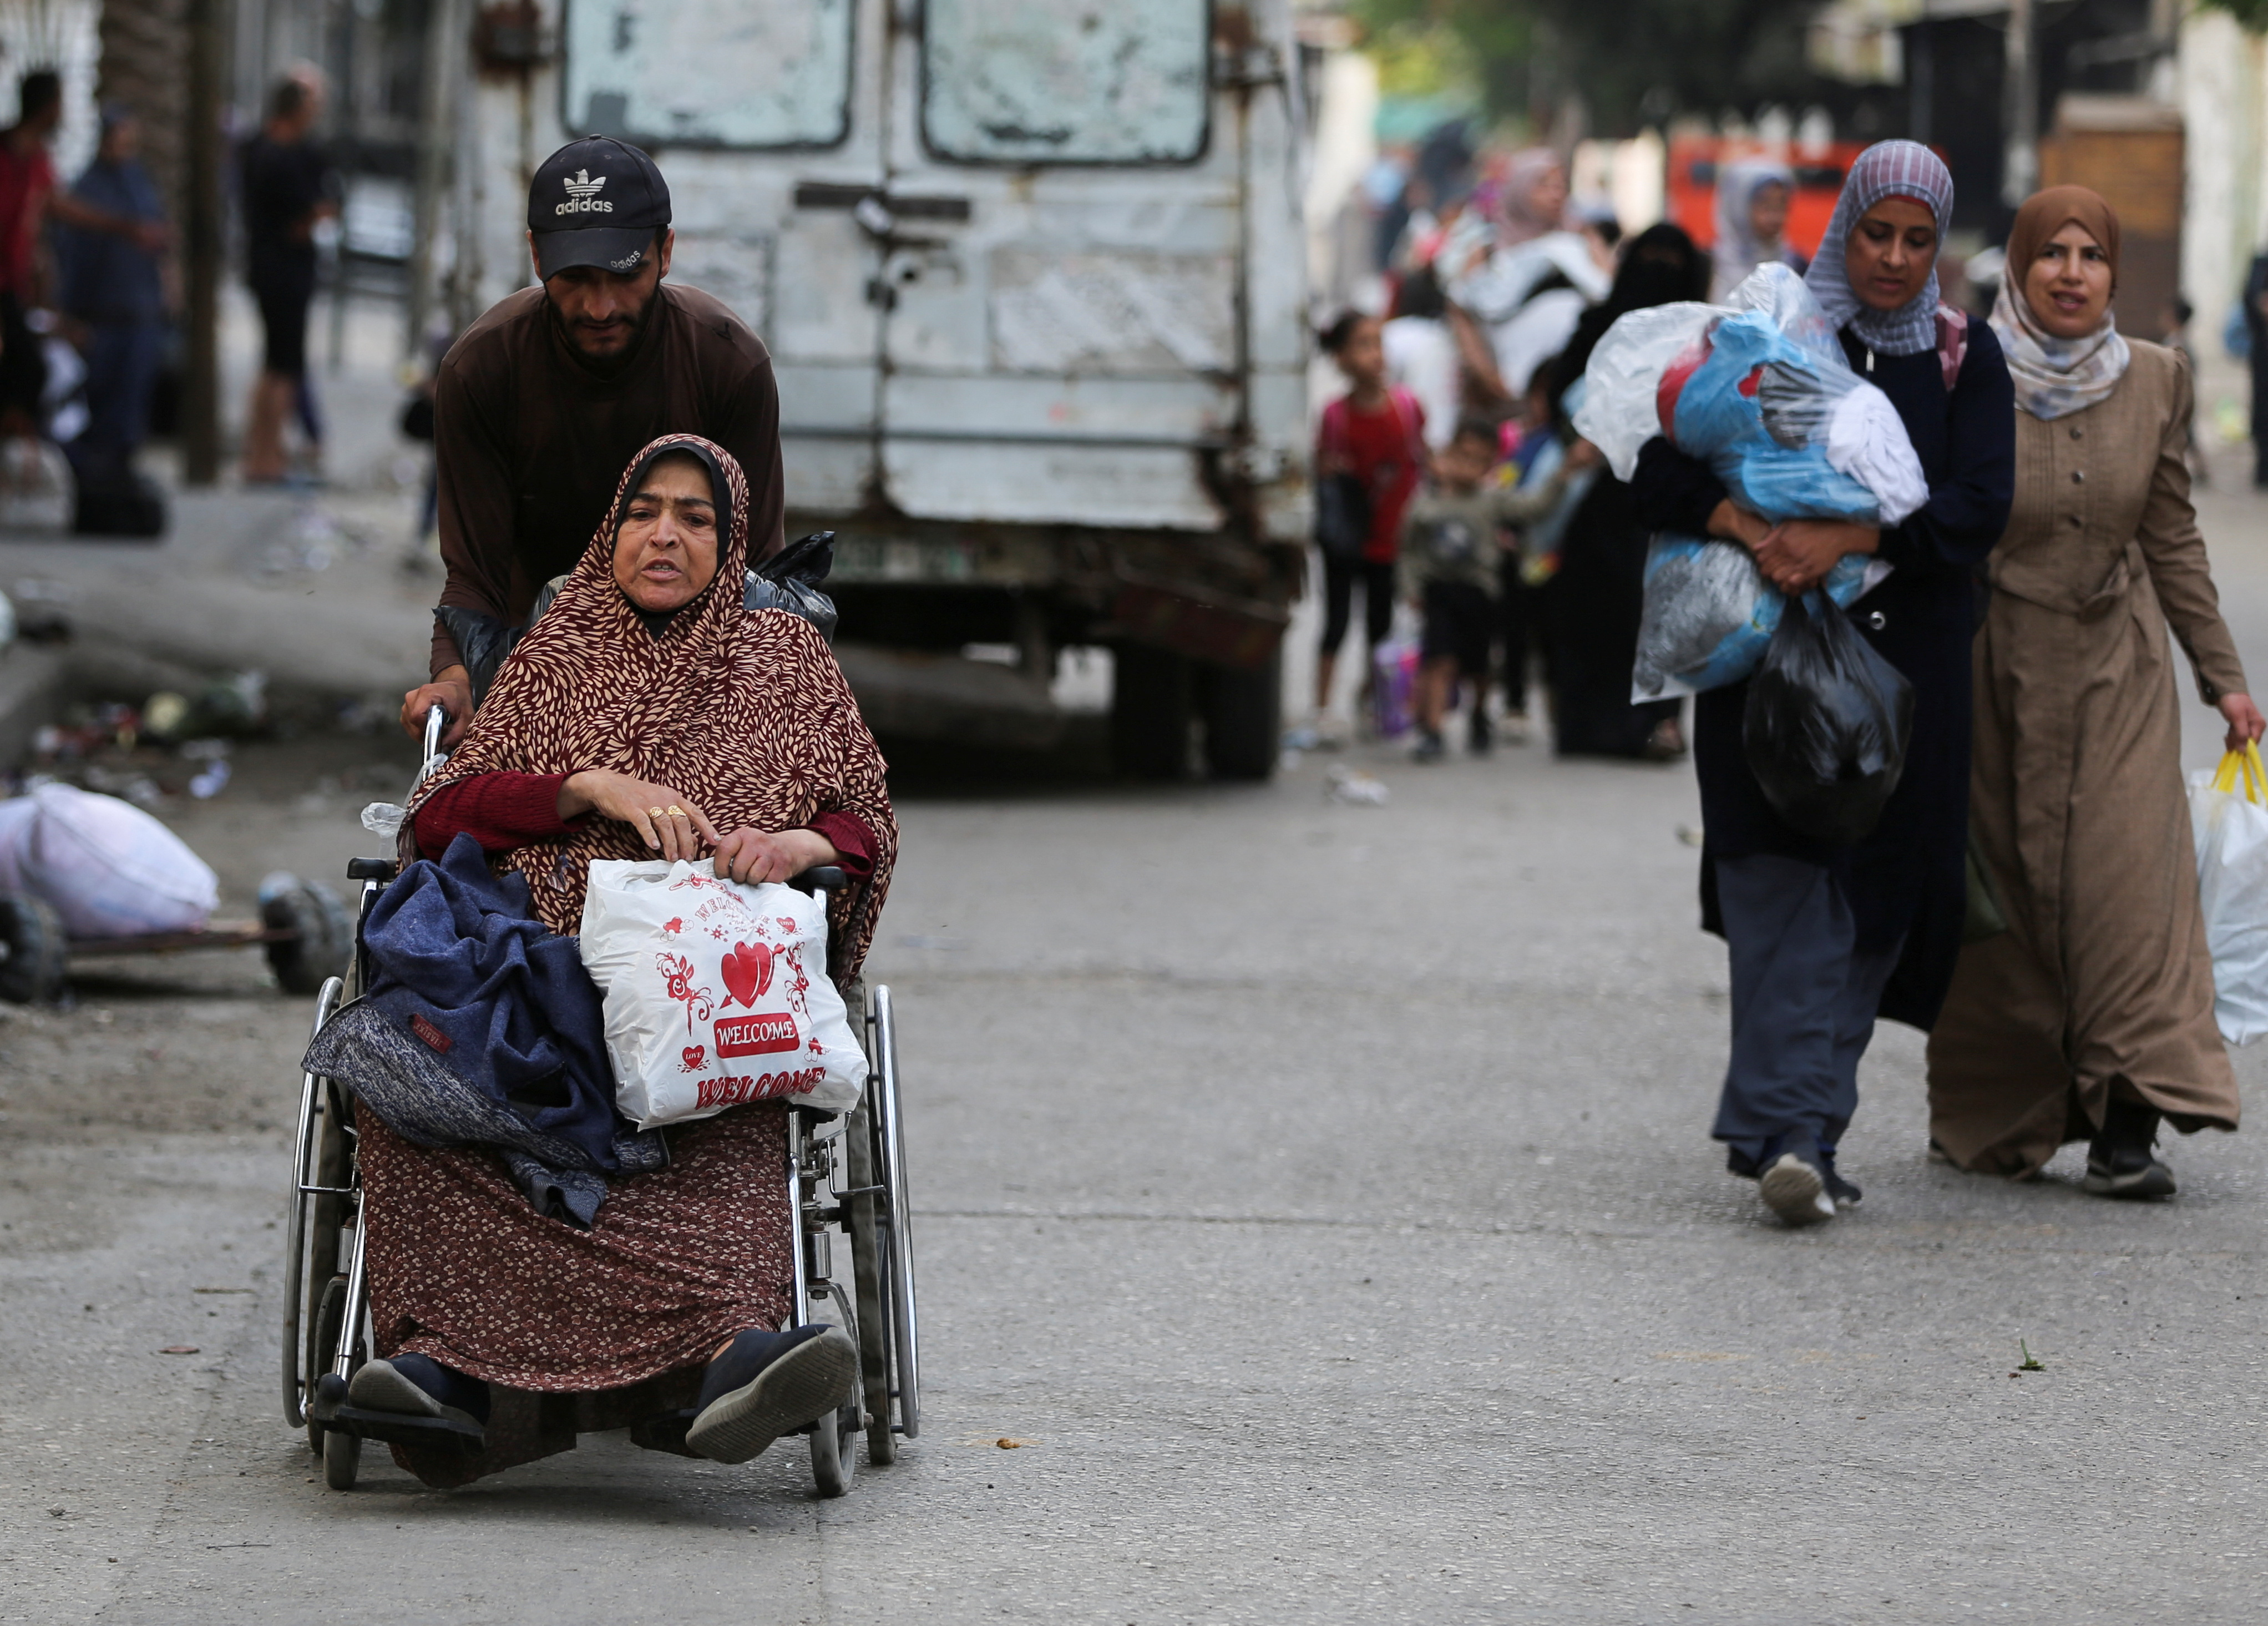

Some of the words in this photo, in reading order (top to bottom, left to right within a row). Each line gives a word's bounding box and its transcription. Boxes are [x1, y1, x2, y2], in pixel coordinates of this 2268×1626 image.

[555, 197, 613, 215] adidas
[610, 250, 640, 269] adidas
[717, 1021, 796, 1046] WELCOME
[685, 1052, 702, 1060] LOVE
[695, 1067, 827, 1110] WELCOME
